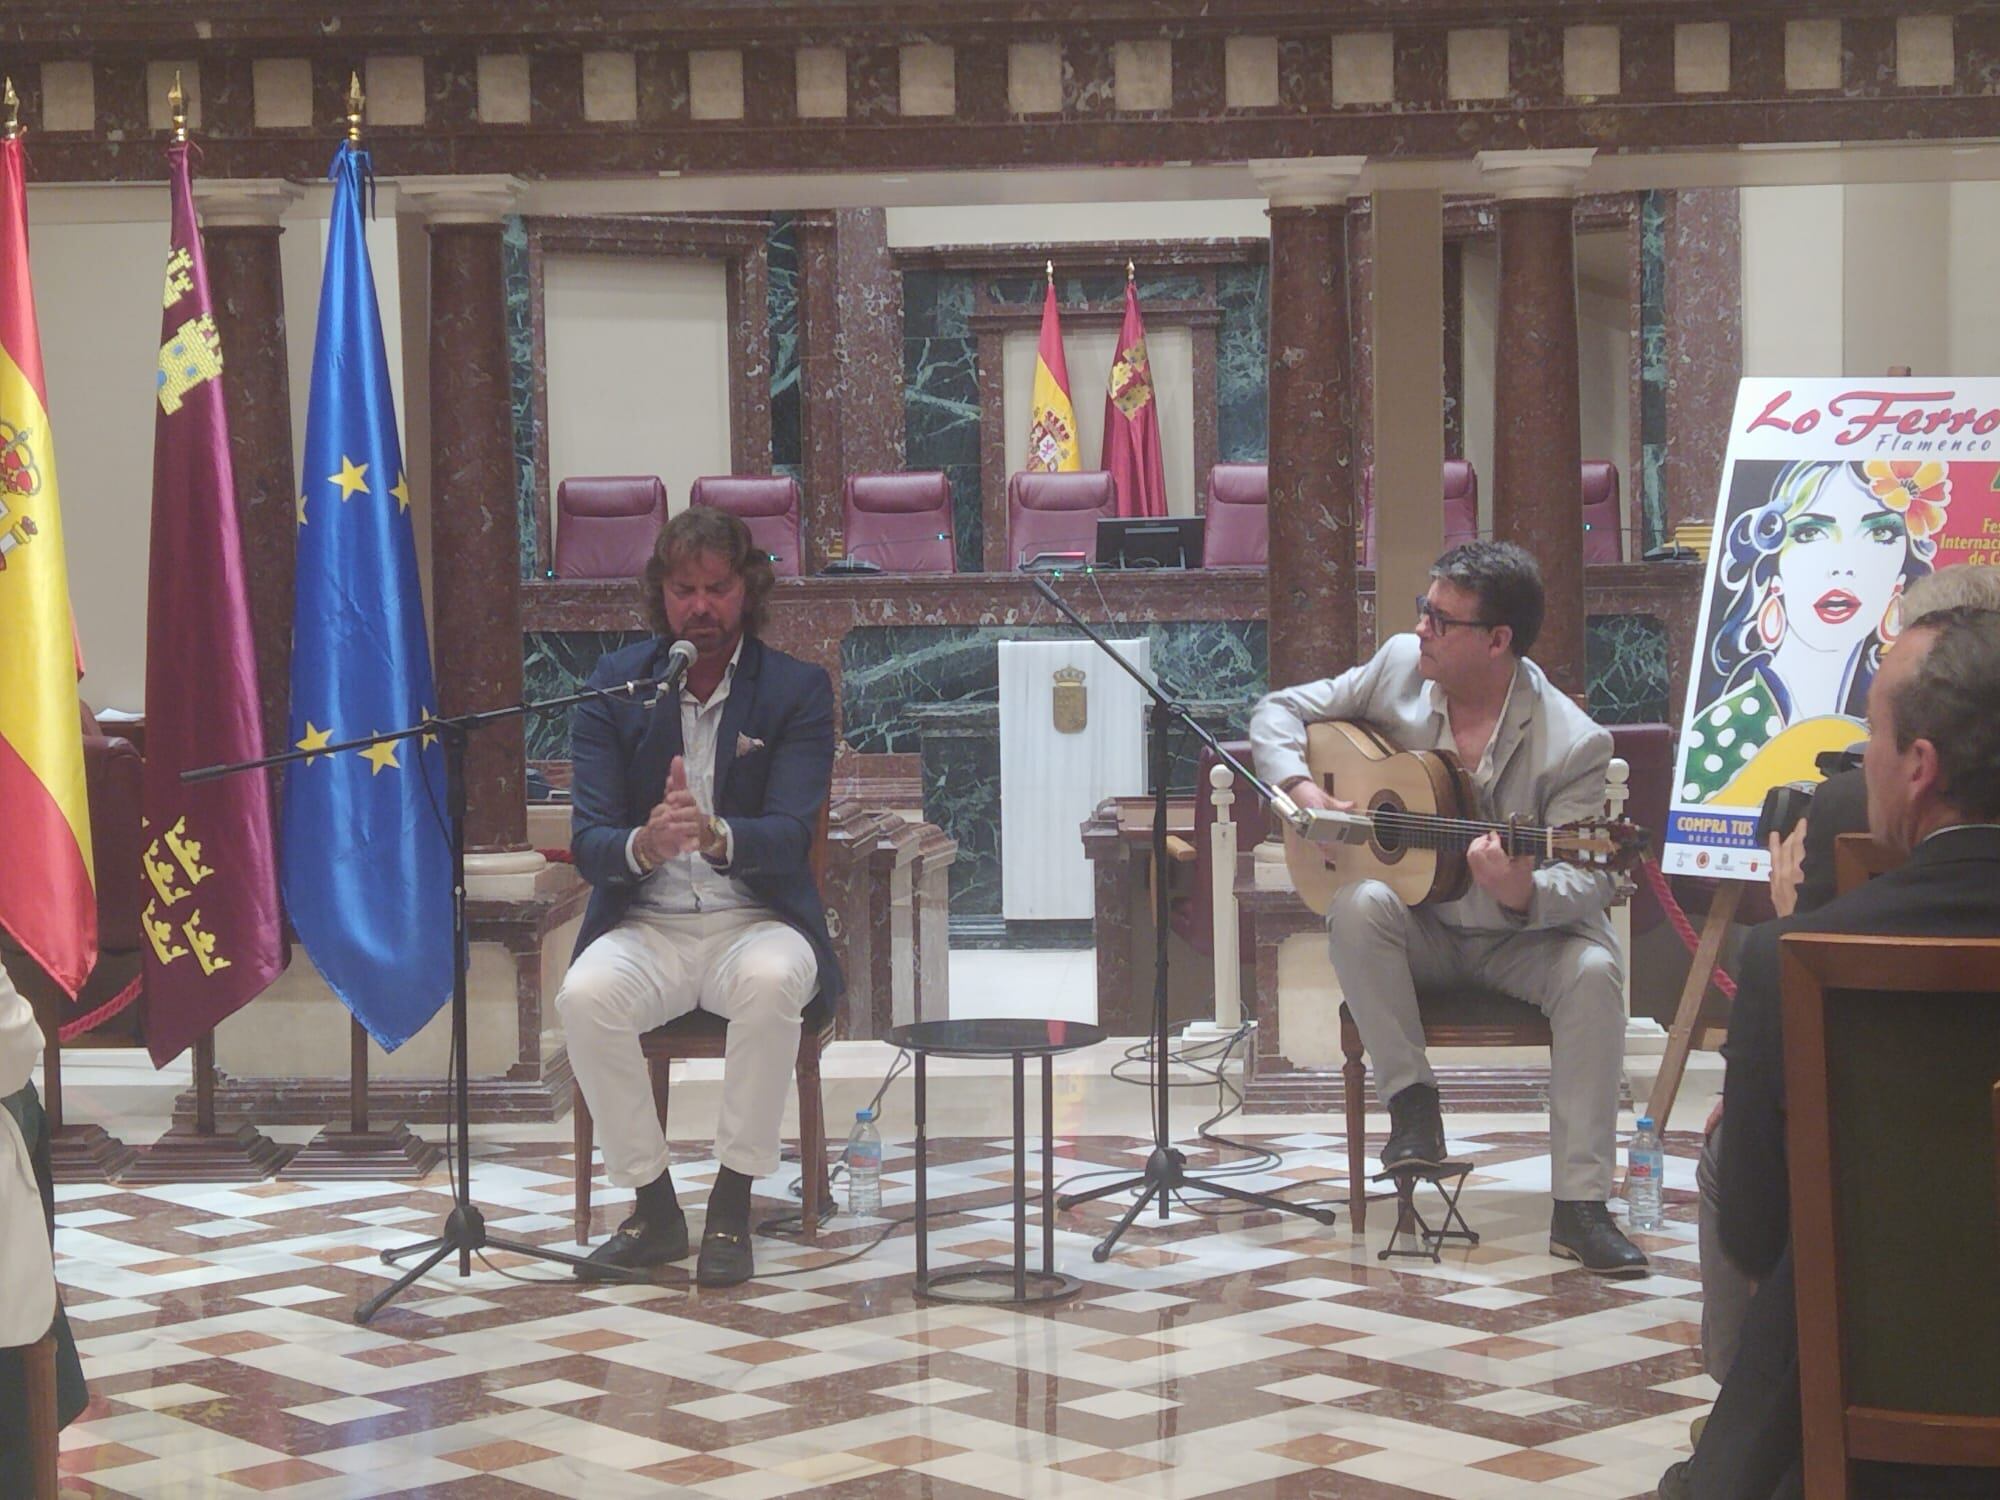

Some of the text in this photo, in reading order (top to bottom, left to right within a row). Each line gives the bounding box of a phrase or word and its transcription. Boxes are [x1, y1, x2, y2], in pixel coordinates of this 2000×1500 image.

[1746, 390, 2000, 446] Lo Ferro
[1876, 433, 1992, 452] Flamenco
[1968, 550, 1985, 566] de
[1677, 816, 1754, 836] COMPRA TUS
